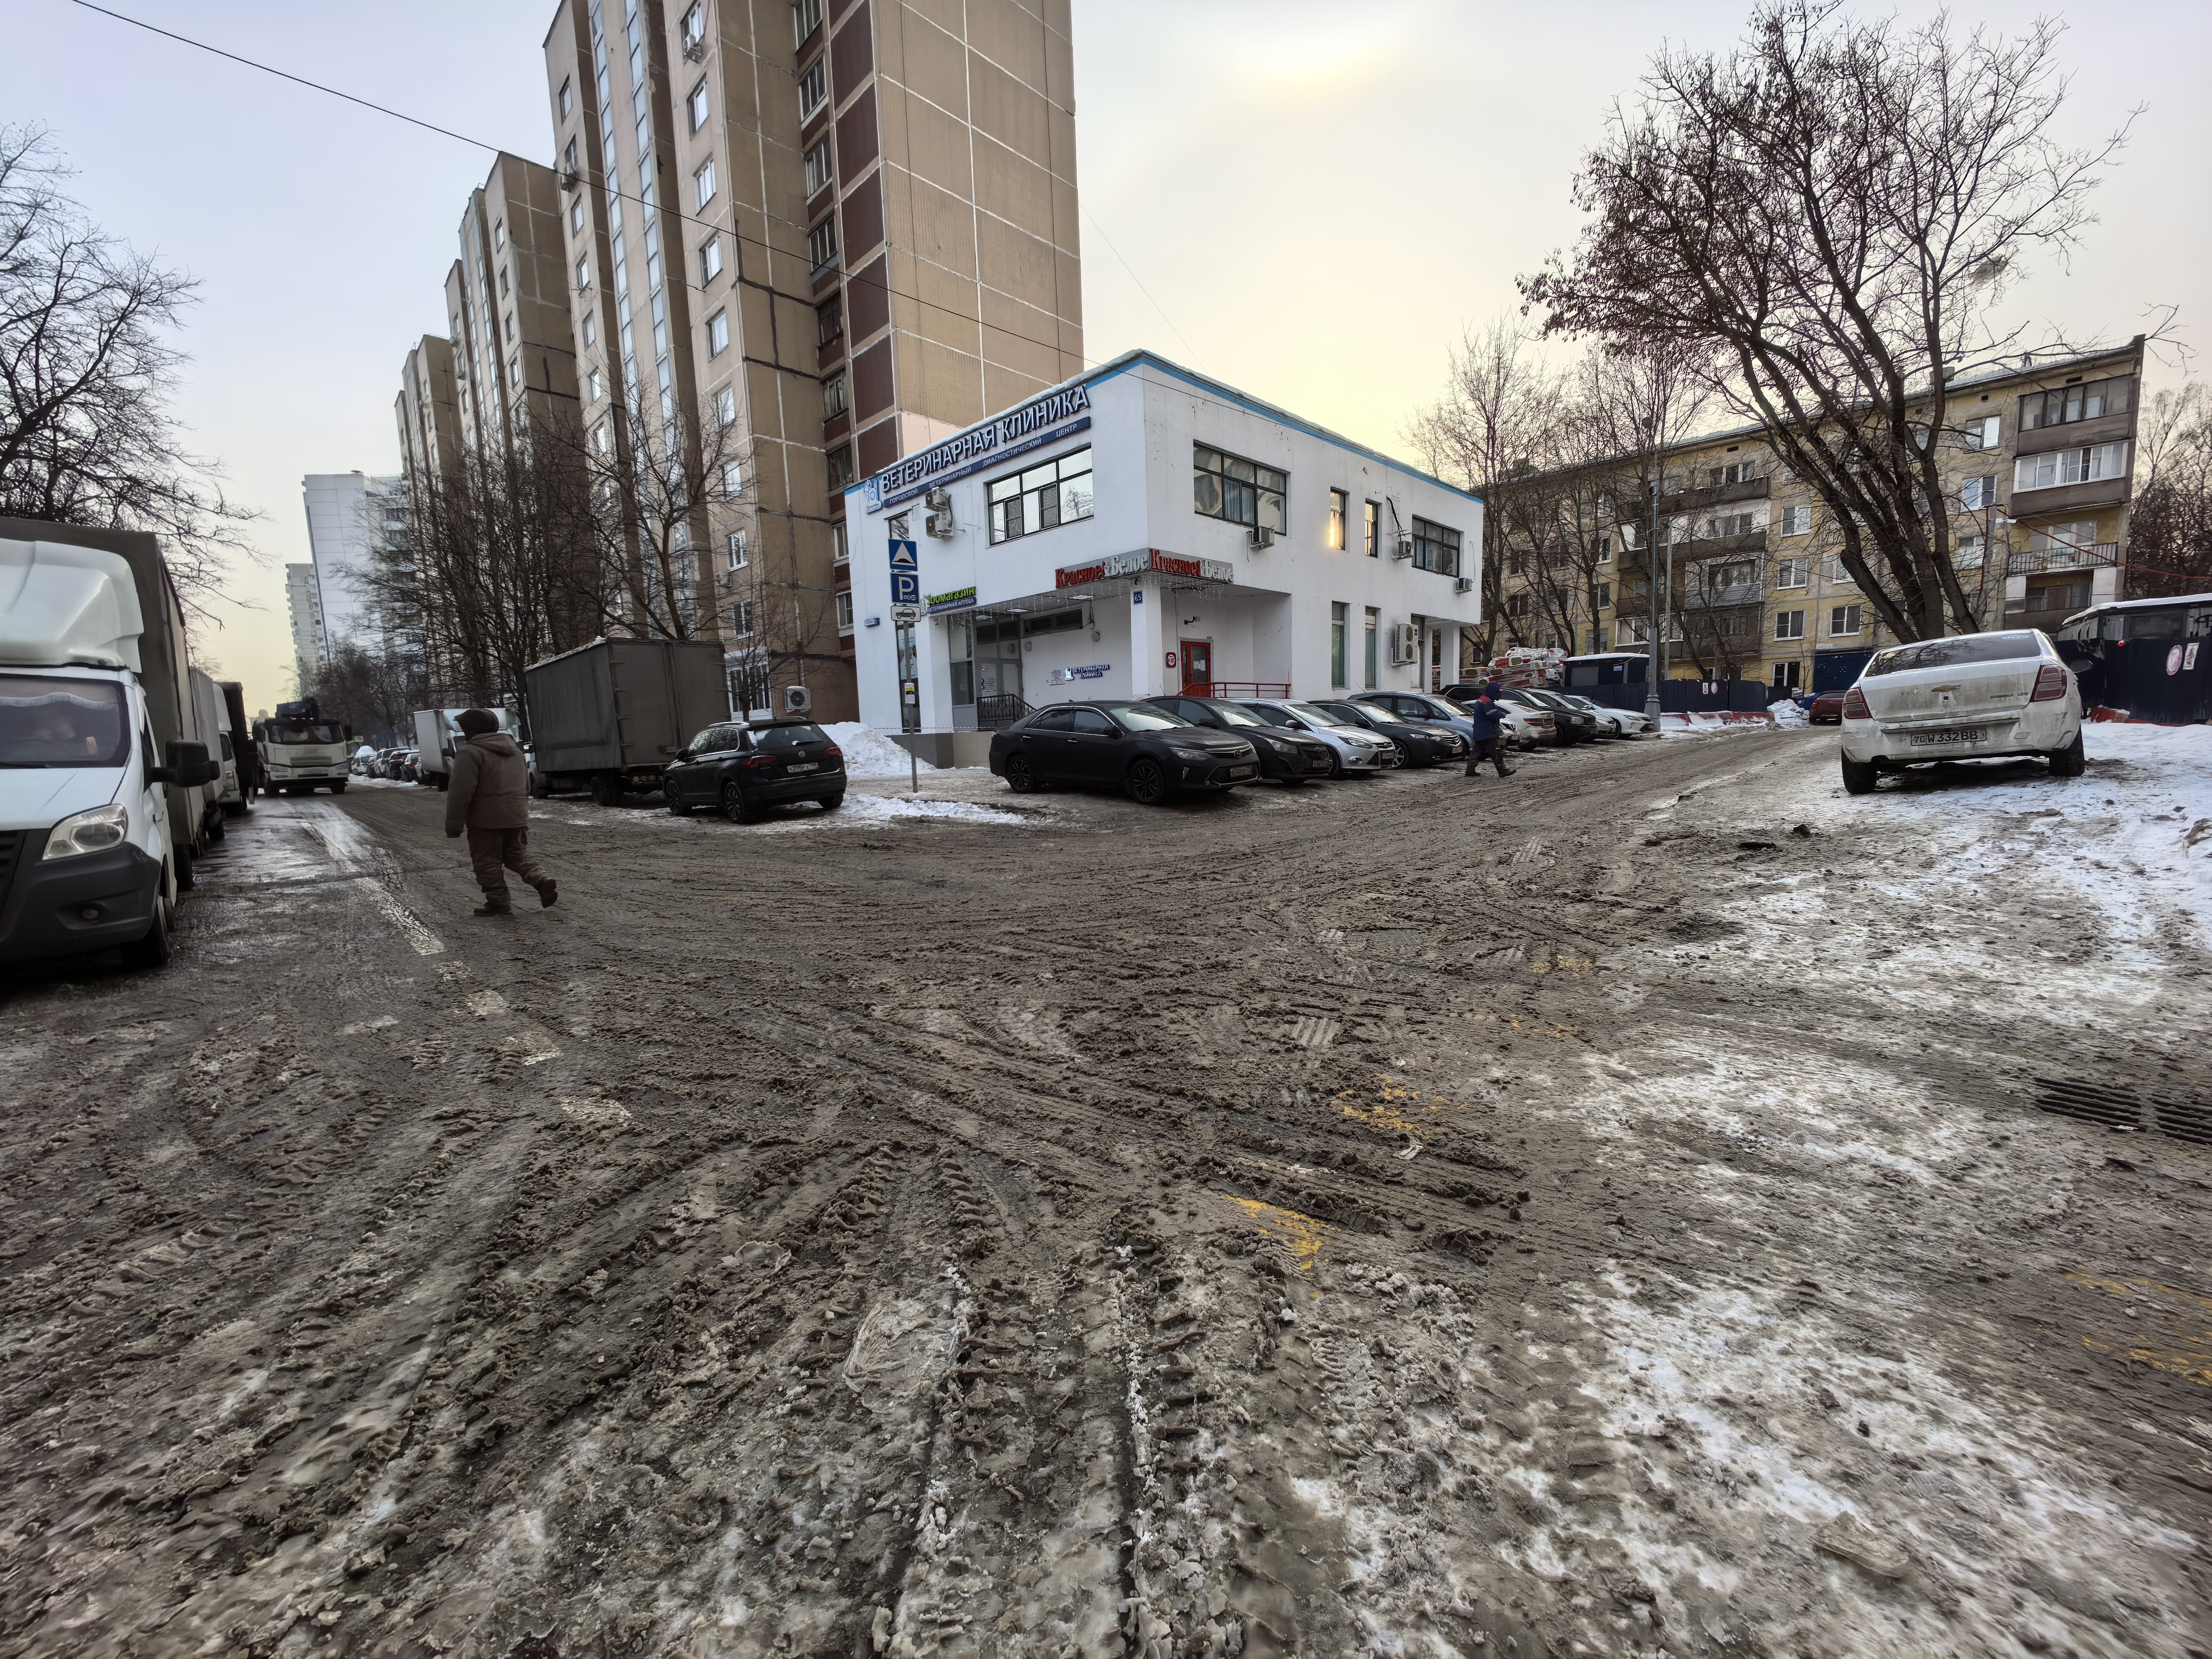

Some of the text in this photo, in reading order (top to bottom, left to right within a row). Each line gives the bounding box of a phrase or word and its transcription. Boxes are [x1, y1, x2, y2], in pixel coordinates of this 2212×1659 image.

[882, 386, 1090, 492] ВЕТЕРИНАРНАЯ КЛИНИКА
[890, 424, 1077, 504] ГОРОДСКОЙ ВЕТЕРИНАРНЫЙ ДИАГНОСТИЧЕСКИЙ ЦЕНТР
[958, 598, 974, 606] АПТЕКА
